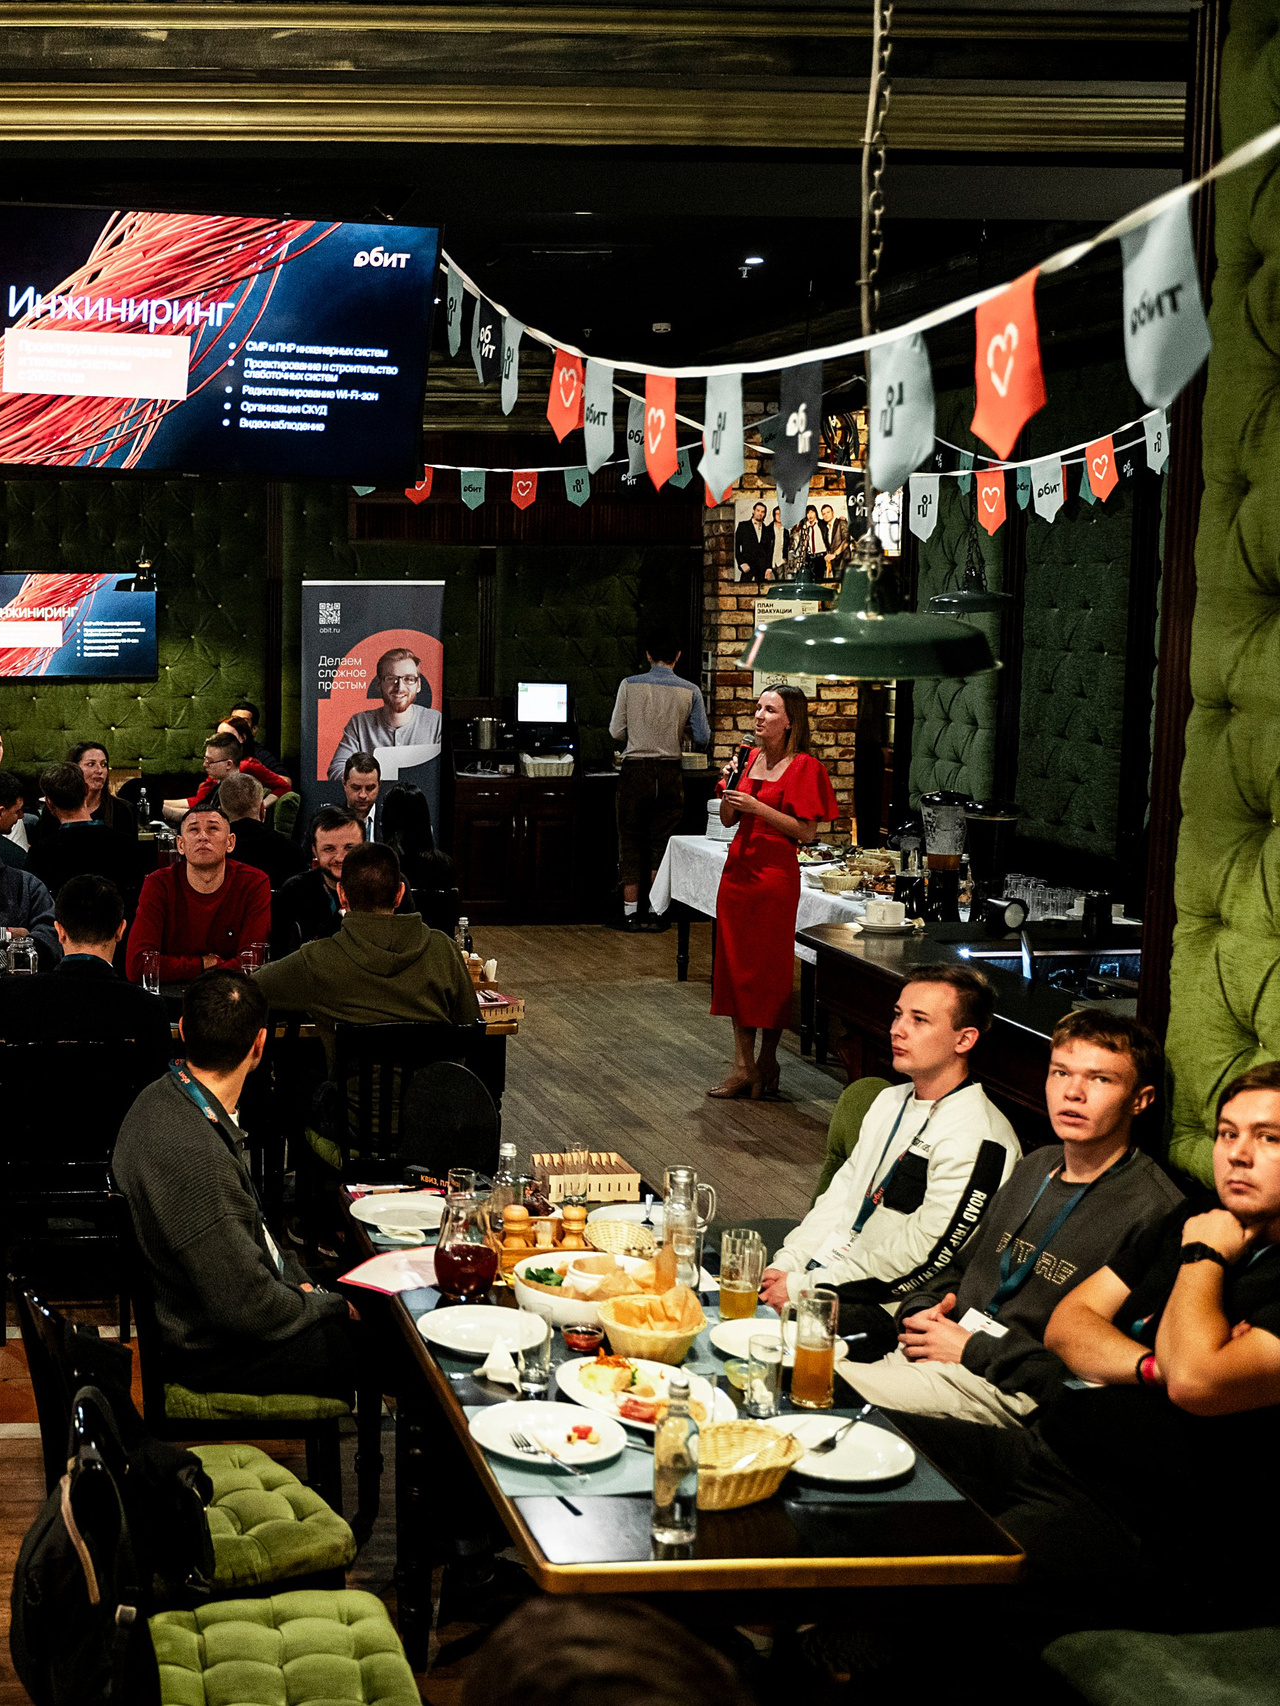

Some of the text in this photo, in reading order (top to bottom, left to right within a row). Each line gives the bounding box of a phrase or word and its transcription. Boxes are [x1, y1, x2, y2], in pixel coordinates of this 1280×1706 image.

[353, 246, 411, 268] обит
[8, 285, 235, 332] Инжиниринг
[296, 345, 353, 357] инженерных
[354, 348, 389, 358] систем
[244, 358, 399, 375] Проектирование и строительство
[243, 370, 339, 382] слаботочных систем
[242, 385, 379, 401] Радиопланирование Wi-Fi-зон
[240, 401, 328, 416] Организация СКУД
[239, 417, 325, 431] Видеонаблюдение
[318, 655, 362, 667] Делаем
[318, 669, 367, 678] сложное
[318, 681, 367, 692] простым
[962, 1189, 988, 1223] ROAD
[950, 1222, 967, 1247] TRIP
